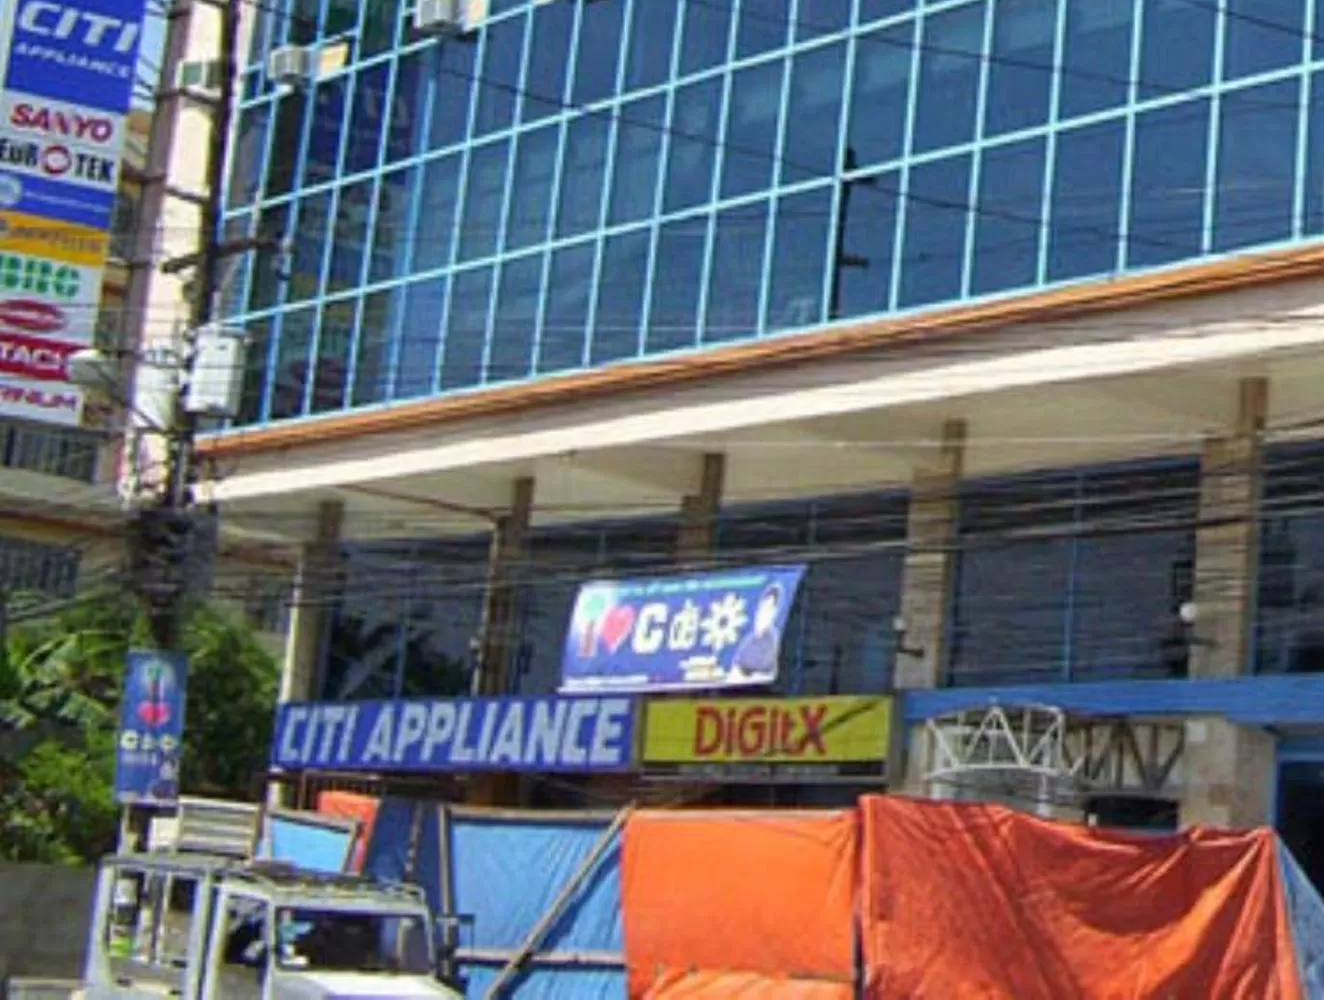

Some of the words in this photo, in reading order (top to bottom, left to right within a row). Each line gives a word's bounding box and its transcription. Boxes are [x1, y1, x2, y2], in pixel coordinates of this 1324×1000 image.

[19, 0, 140, 52] CITI
[10, 103, 113, 143] SANYO
[278, 704, 360, 764] CITI
[360, 699, 631, 765] APPLIANCE
